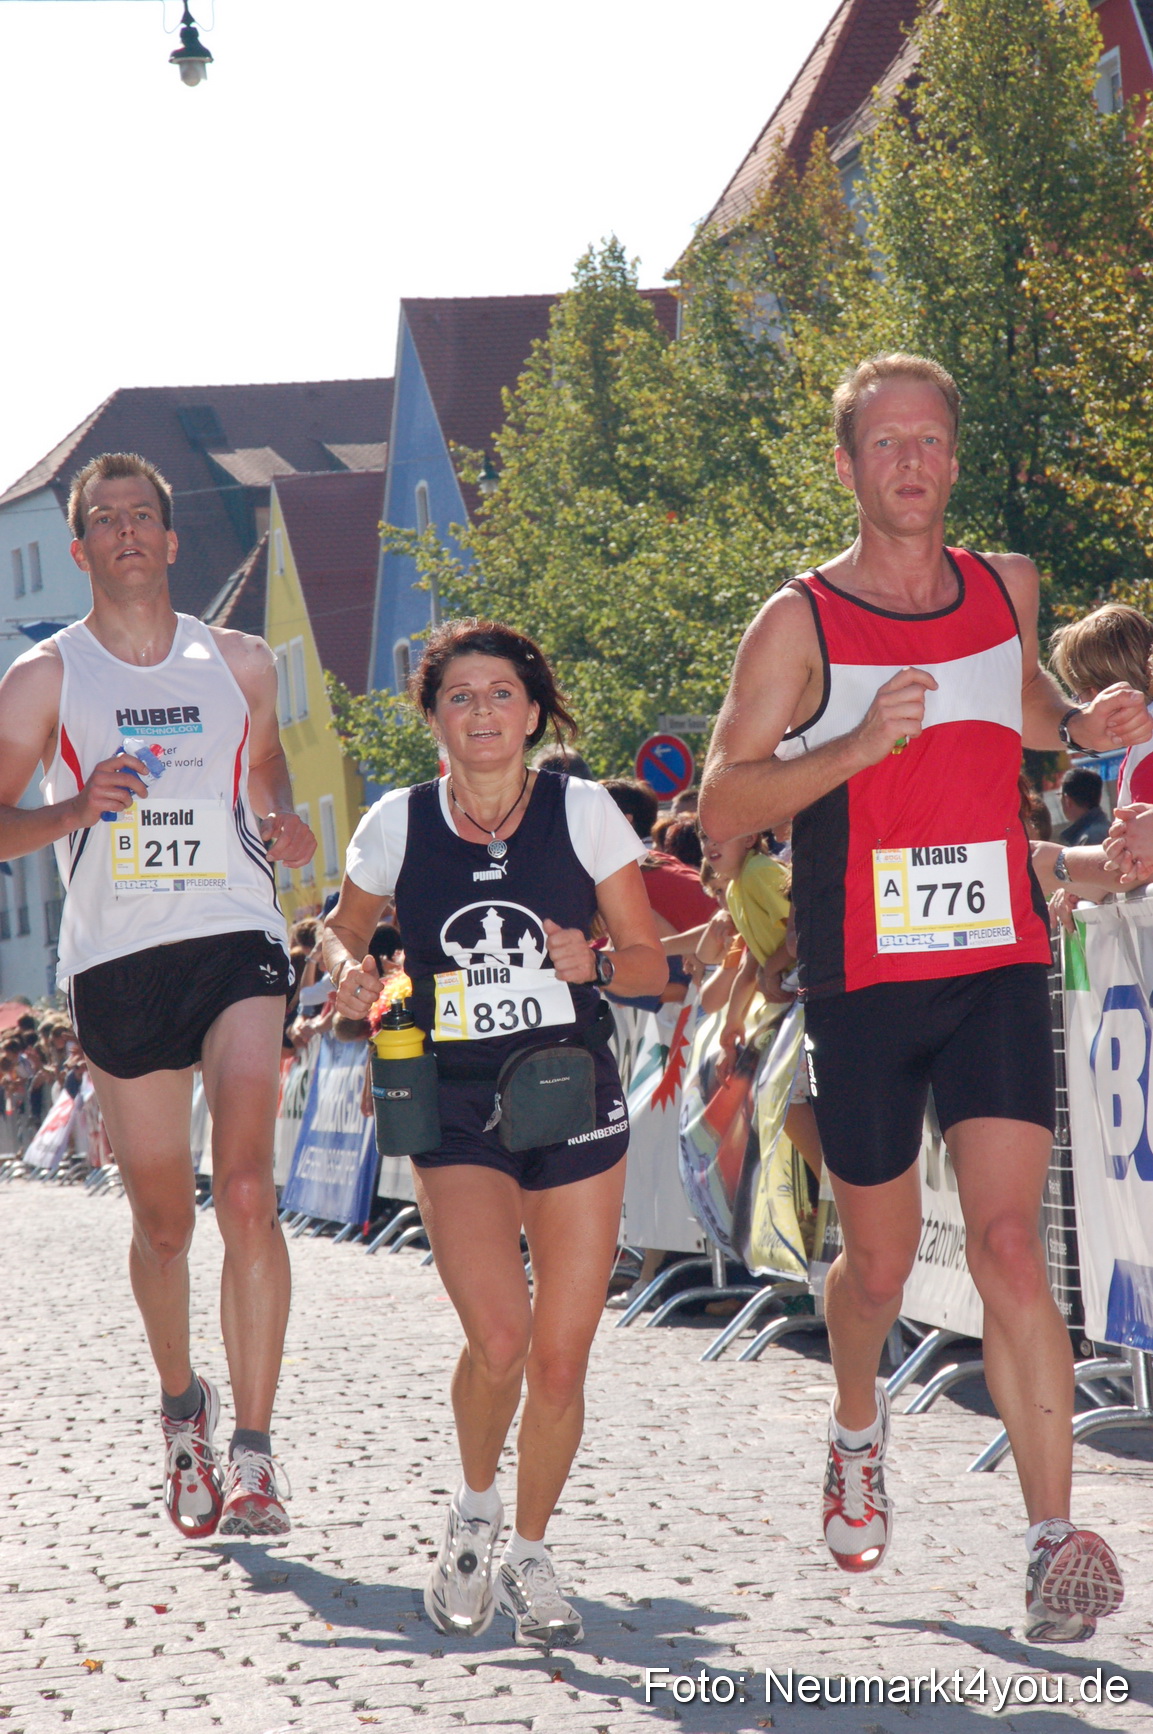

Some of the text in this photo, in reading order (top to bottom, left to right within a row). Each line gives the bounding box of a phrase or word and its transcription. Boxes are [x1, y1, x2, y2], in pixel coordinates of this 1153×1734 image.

[116, 706, 201, 727] HUBER
[134, 725, 199, 735] TECHNOLOGY
[174, 757, 203, 768] world
[141, 809, 194, 826] Harald
[119, 835, 131, 850] B
[145, 840, 201, 867] 217
[911, 845, 968, 867] Klaus
[186, 879, 227, 888] PFLEIDERER
[472, 869, 502, 882] PUMA
[884, 879, 900, 897] A
[917, 880, 985, 917] 776
[879, 933, 935, 947] BOCK
[968, 926, 1013, 940] PFLEIDERER
[467, 967, 510, 987] Julia
[443, 1000, 458, 1017] A
[473, 996, 542, 1033] 830
[539, 1076, 570, 1085] SALOMON
